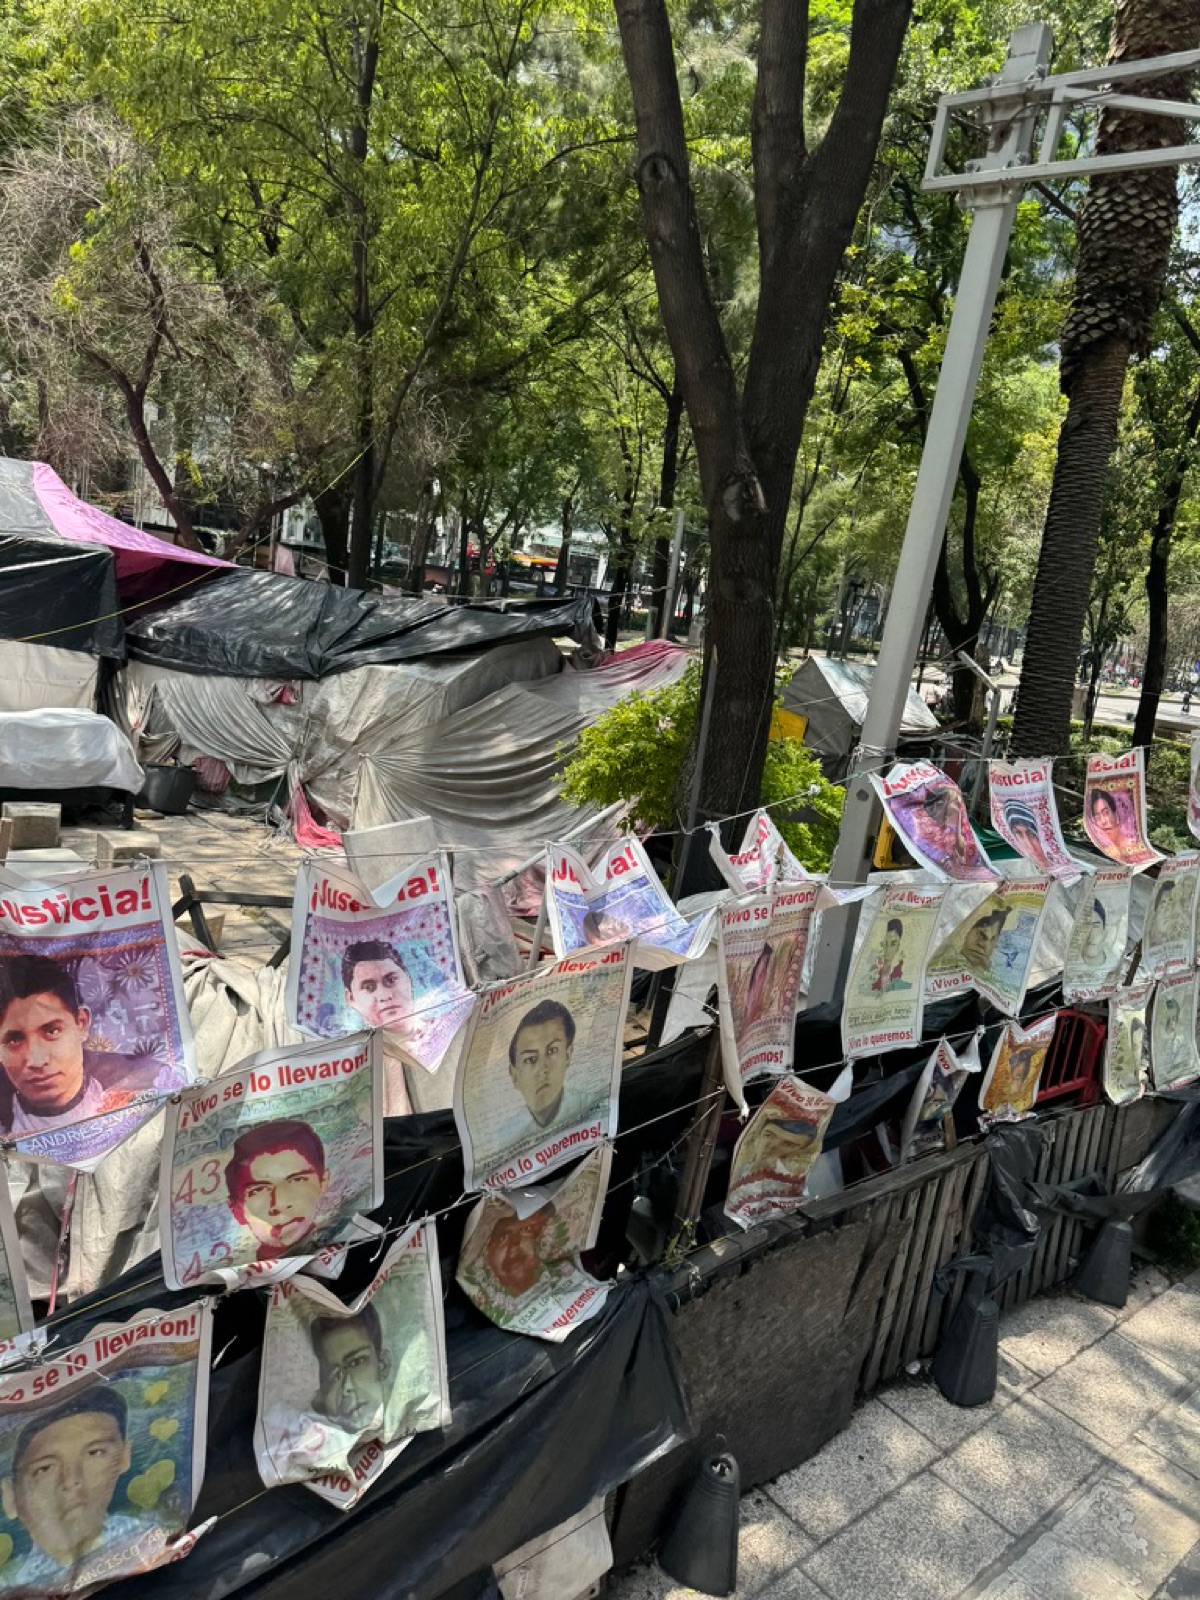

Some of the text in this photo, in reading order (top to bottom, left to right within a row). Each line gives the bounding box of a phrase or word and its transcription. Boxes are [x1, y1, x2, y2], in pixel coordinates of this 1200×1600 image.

[754, 907, 768, 920] se
[930, 978, 960, 993] ¡Vivo
[961, 973, 972, 985] lo
[181, 1094, 218, 1128] ¡Vivo
[223, 1081, 243, 1102] se
[250, 1071, 271, 1093] lo
[278, 1046, 368, 1087] llevaron!
[29, 1122, 104, 1151] ANDRES
[518, 1154, 534, 1176] lo
[536, 1122, 601, 1167] queremos!
[175, 1159, 221, 1204] 43
[33, 1365, 59, 1395] se
[66, 1352, 87, 1376] lo
[94, 1314, 196, 1362] llevaron!
